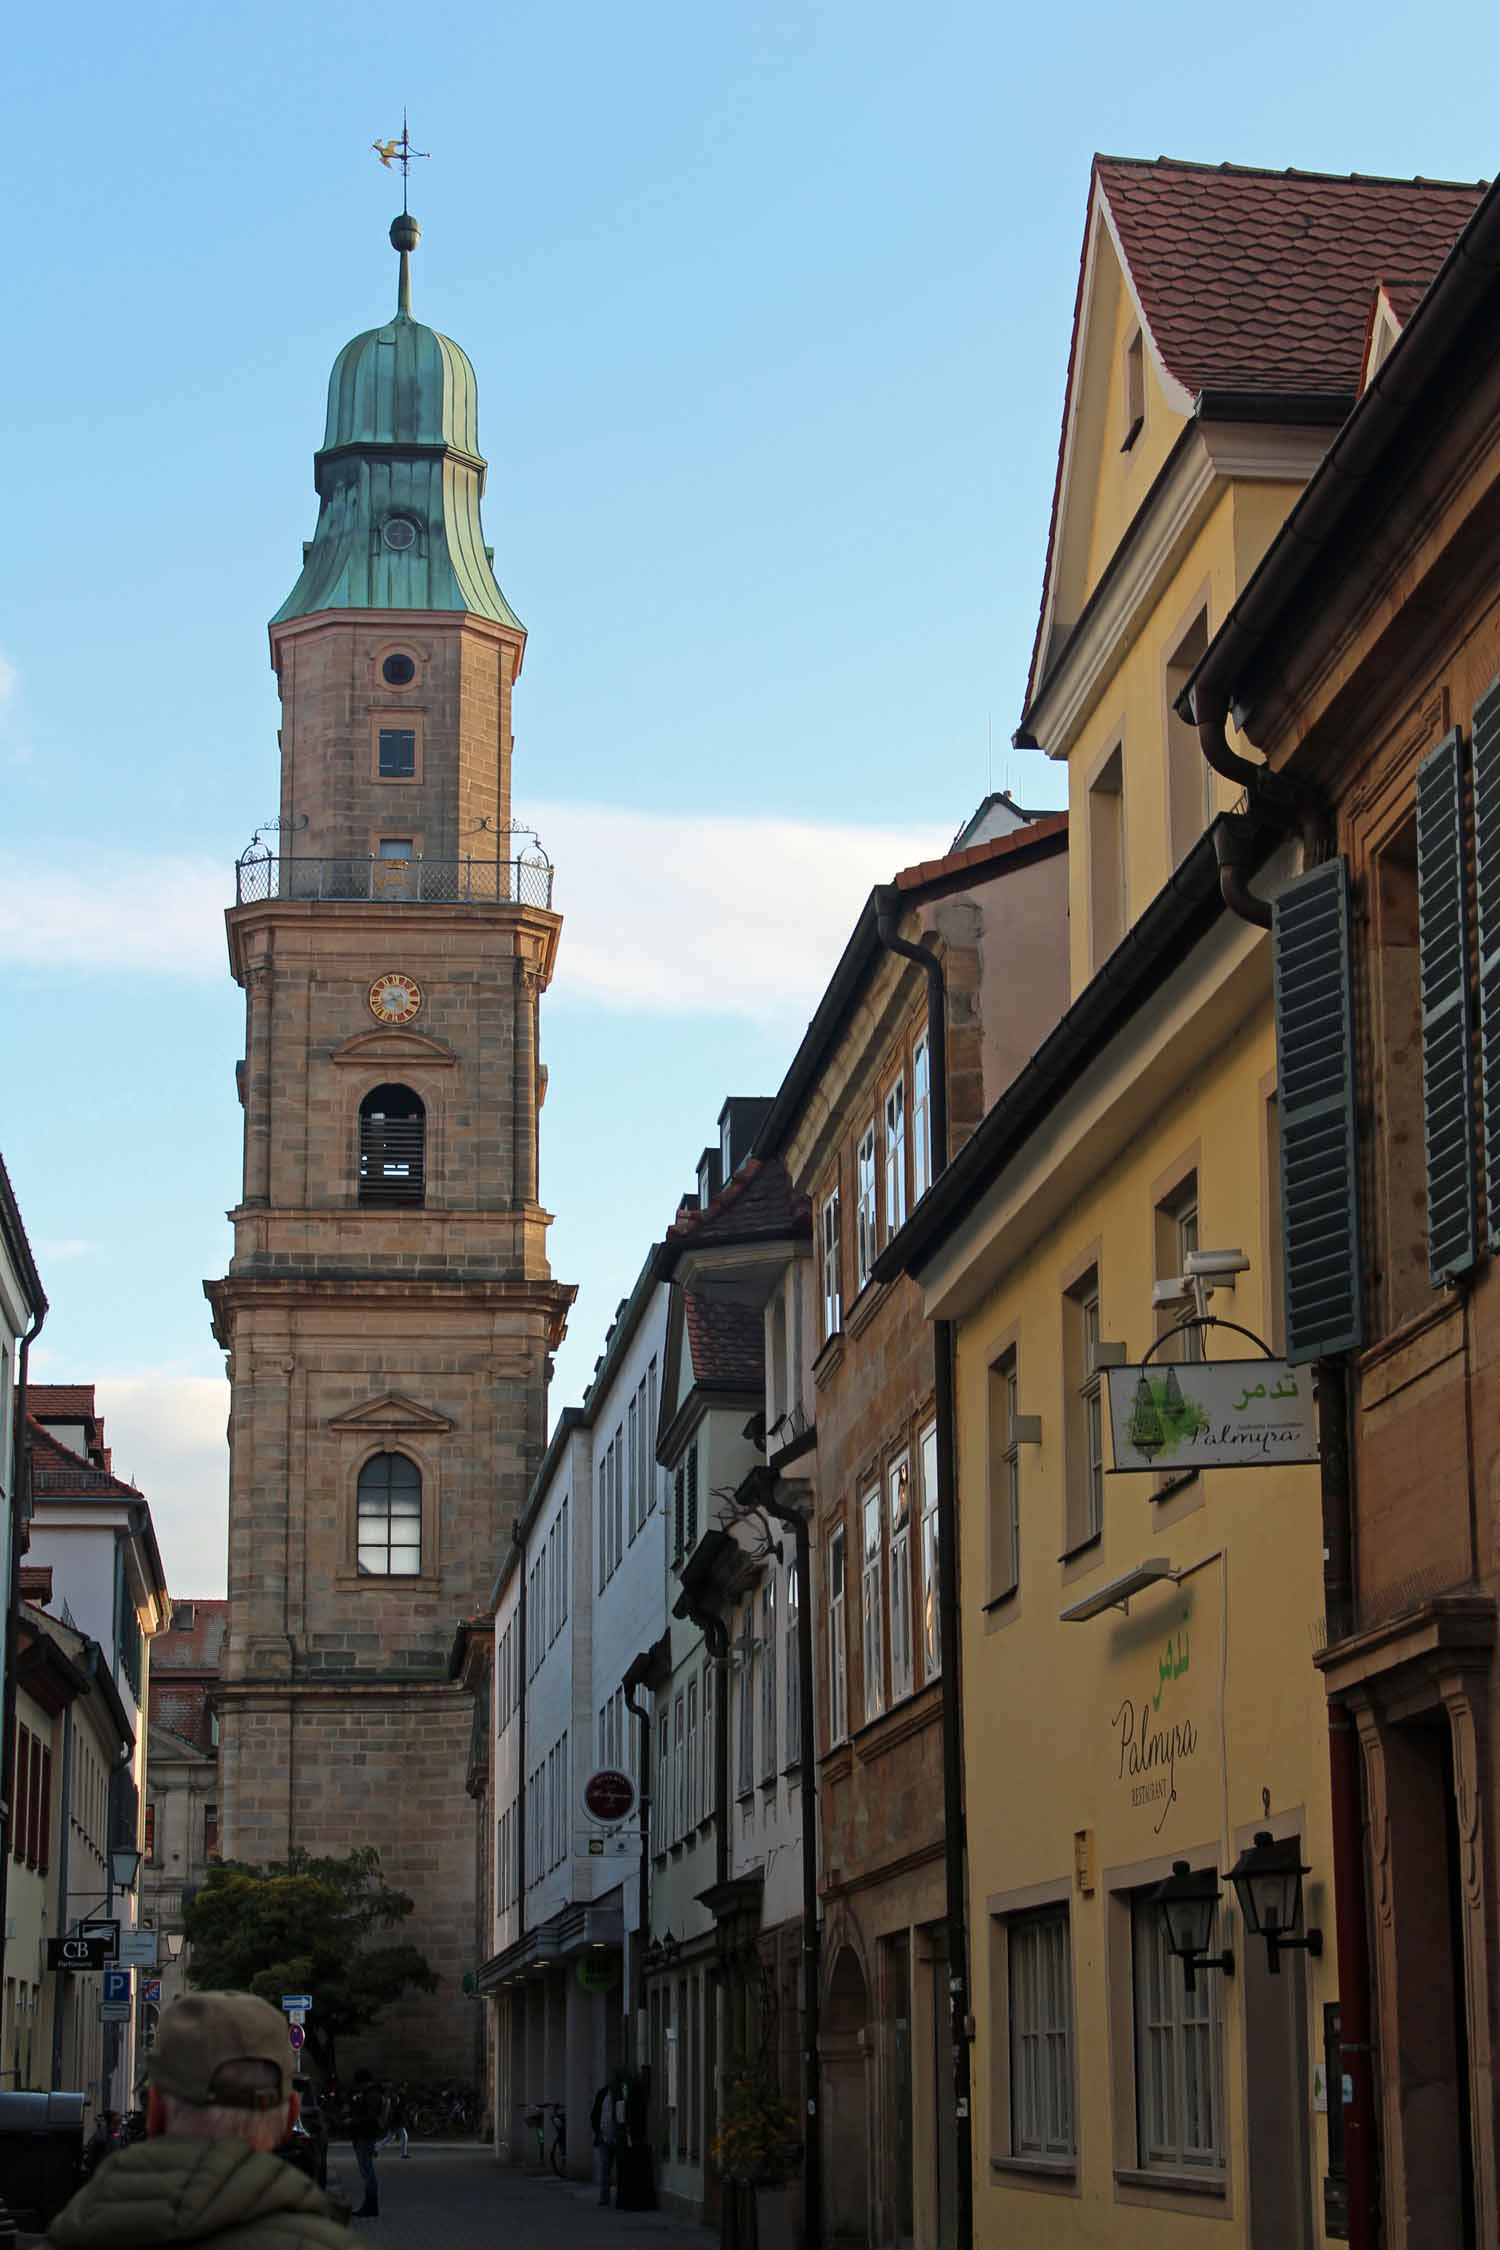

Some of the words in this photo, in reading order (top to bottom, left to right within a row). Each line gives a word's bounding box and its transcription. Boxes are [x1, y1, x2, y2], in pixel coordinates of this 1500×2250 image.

[1232, 1372, 1299, 1410] تدمر
[1190, 1424, 1303, 1453] Palmyra
[1112, 1699, 1198, 1834] Palmyra
[63, 1941, 89, 1959] CB
